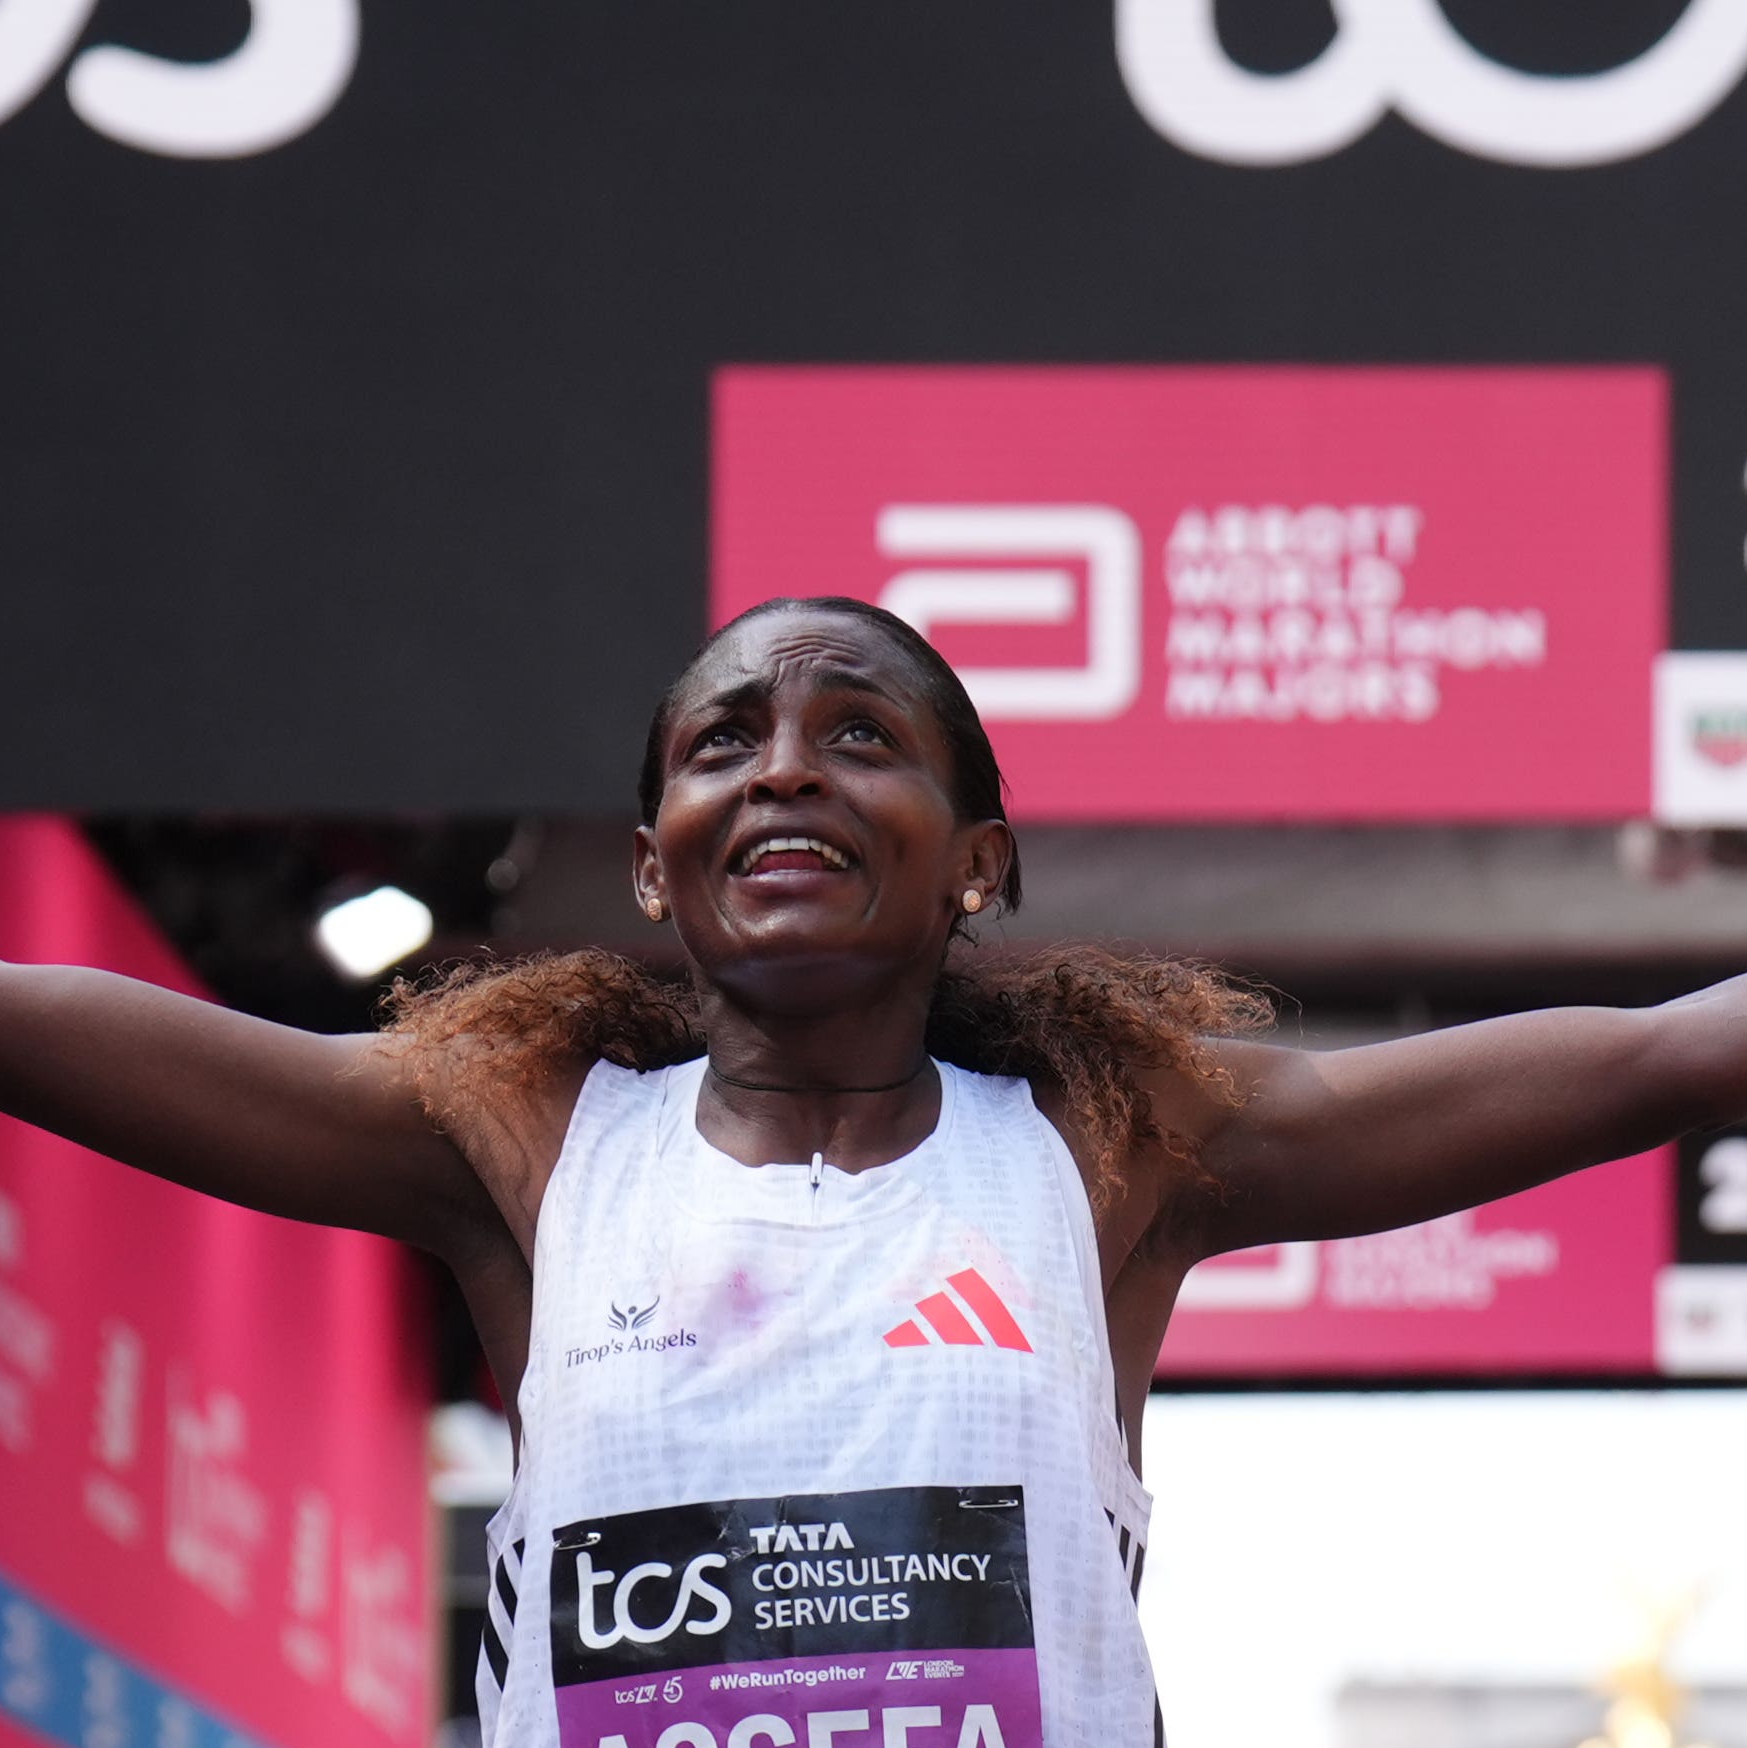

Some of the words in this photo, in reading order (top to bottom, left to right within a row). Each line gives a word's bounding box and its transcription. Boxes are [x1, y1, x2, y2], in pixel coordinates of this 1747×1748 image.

[1164, 503, 1424, 565] ABBOTT
[1166, 555, 1404, 612] WORLD
[1166, 607, 1549, 669] MARATHON
[1166, 662, 1442, 724] MAJORS
[565, 1338, 624, 1368] Tirop's
[627, 1328, 698, 1353] Angels
[749, 1522, 855, 1554] TATA
[752, 1553, 991, 1592] CONSULTANCY
[576, 1551, 732, 1650] tcs
[754, 1592, 910, 1630] SERVICES
[709, 1665, 866, 1691] #WeRunTogether
